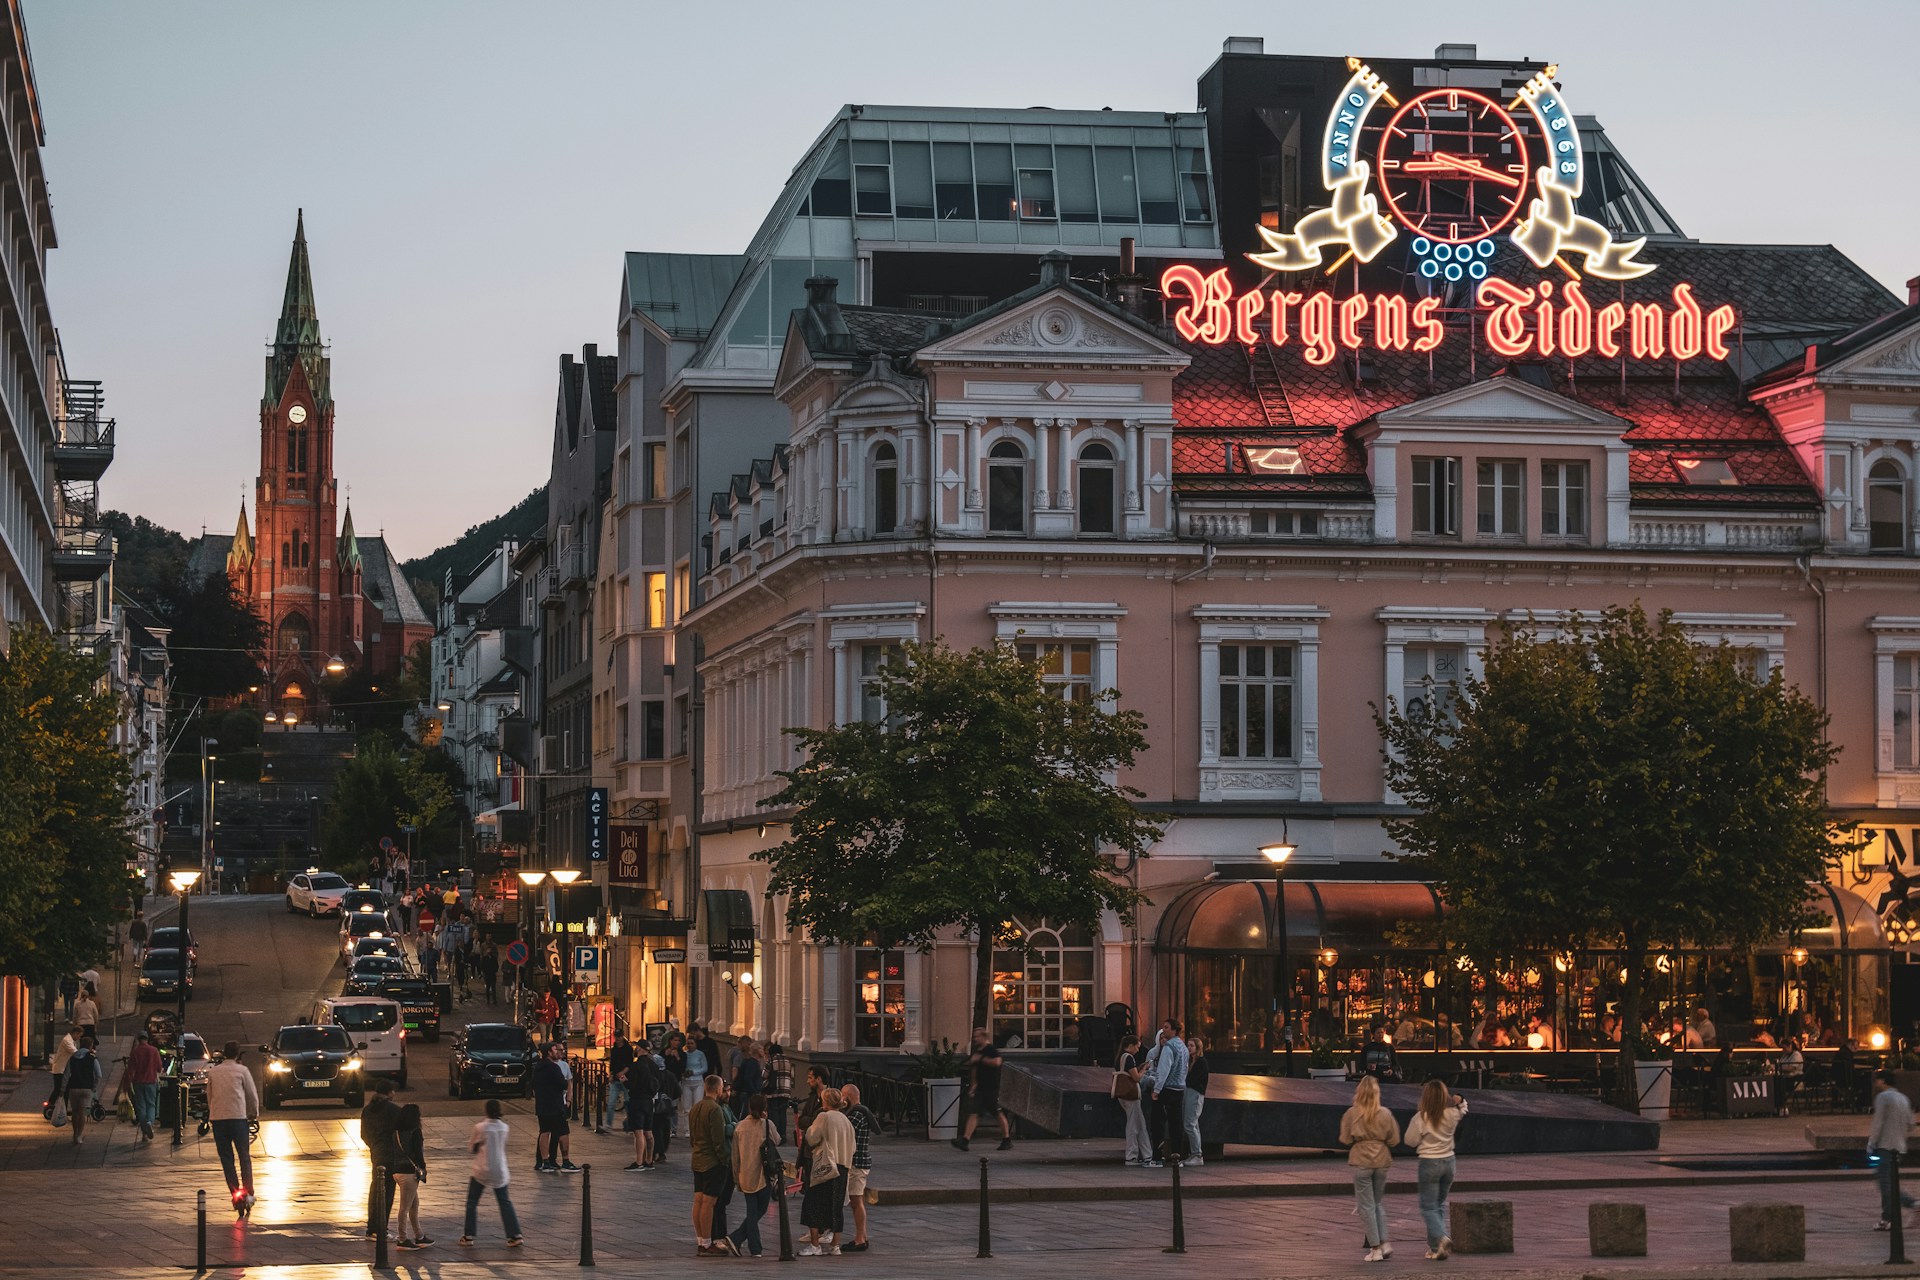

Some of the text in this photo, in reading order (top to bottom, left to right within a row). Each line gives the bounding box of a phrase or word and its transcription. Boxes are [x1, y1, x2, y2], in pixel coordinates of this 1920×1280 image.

[1331, 92, 1365, 167] ANNO
[1541, 98, 1577, 174] 1868
[1160, 264, 1735, 366] Bergens Tidende
[1435, 653, 1456, 671] ak
[591, 791, 601, 859] ACTICO
[620, 831, 638, 848] Deli
[625, 852, 634, 862] de
[619, 860, 639, 877] Luca
[730, 939, 752, 949] MM
[580, 949, 594, 968] P
[1732, 1081, 1768, 1099] MM
